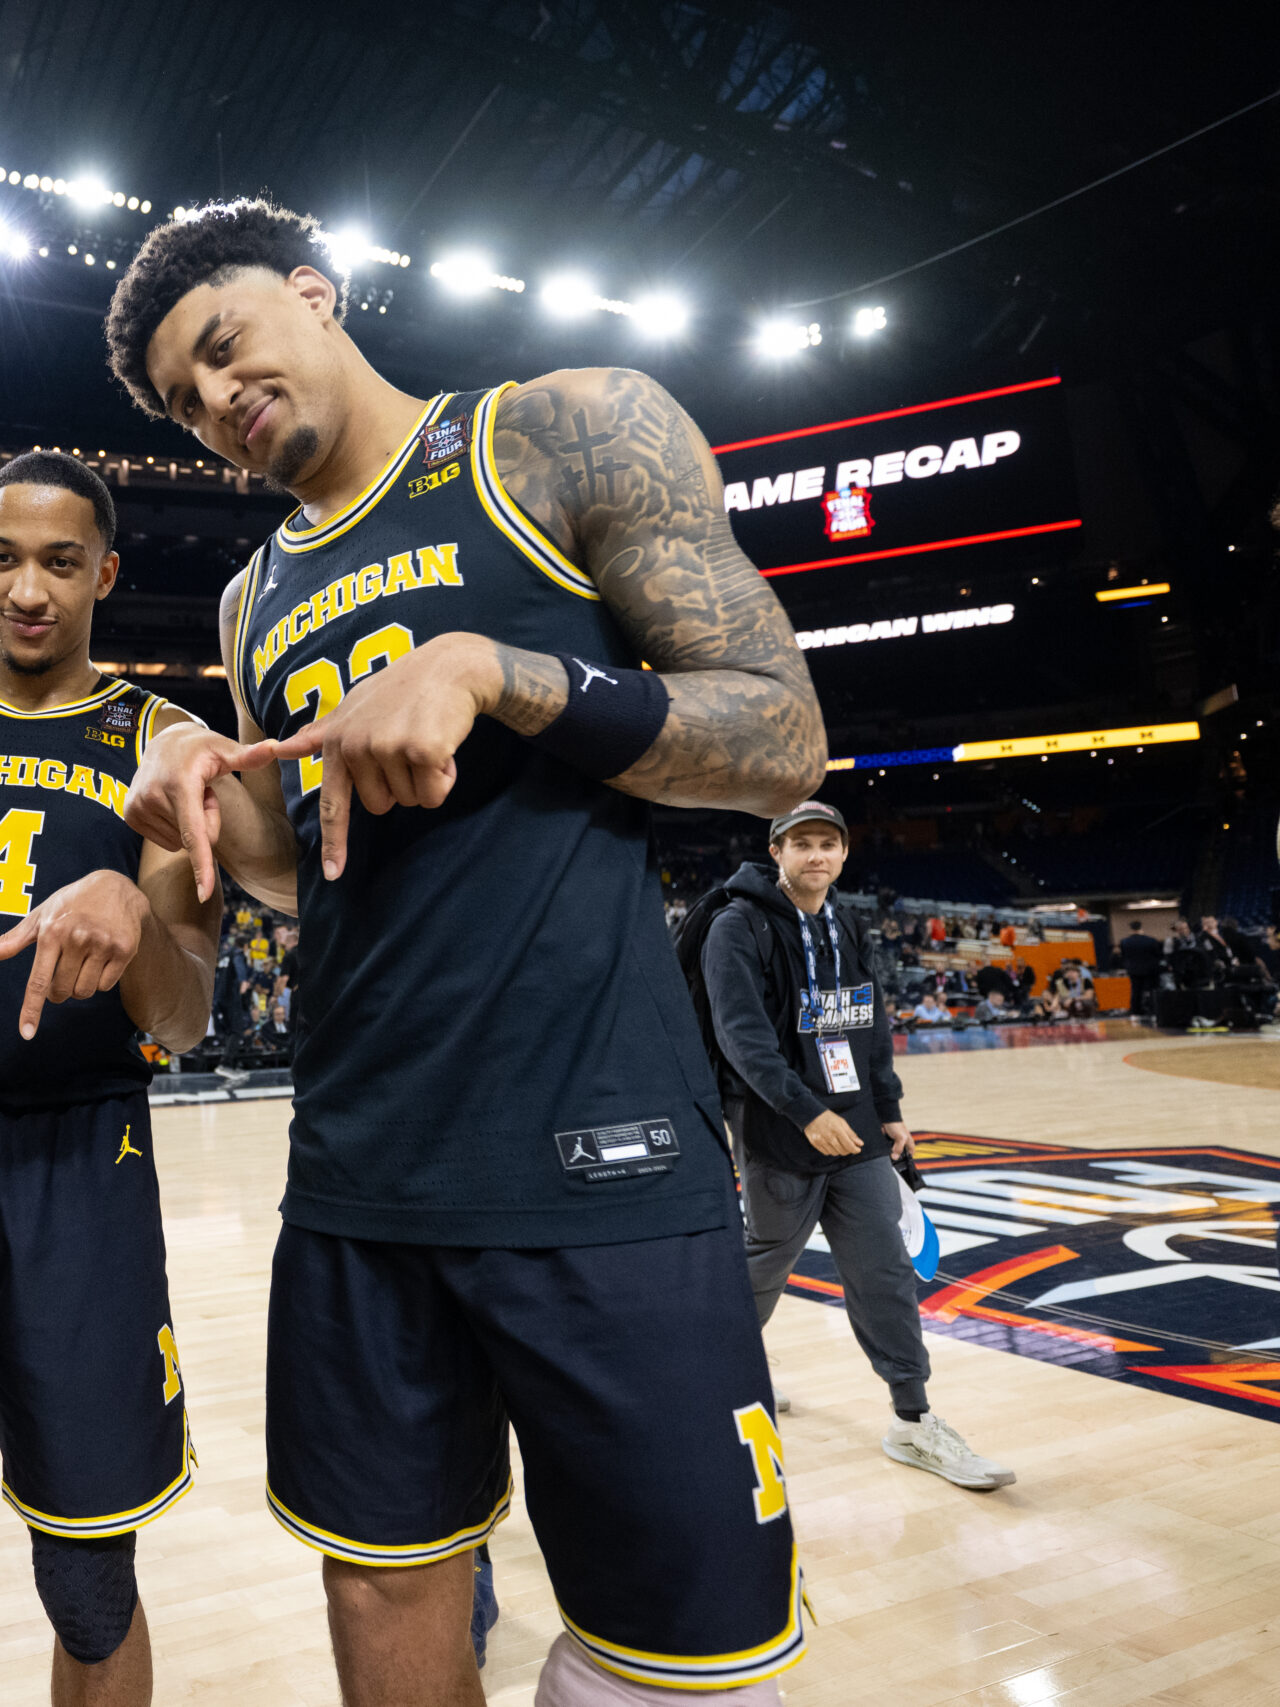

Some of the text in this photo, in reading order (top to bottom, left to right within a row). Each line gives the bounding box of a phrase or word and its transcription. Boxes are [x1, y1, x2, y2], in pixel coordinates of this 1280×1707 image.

[426, 422, 462, 443] FINAL
[429, 439, 463, 461] FOUR
[723, 430, 1021, 513] AME RECAP
[253, 543, 464, 690] MICHIGAN
[795, 603, 1016, 650] CHIGAN WINS
[107, 704, 134, 715] FINAL
[105, 717, 132, 727] FOUR
[649, 1129, 672, 1146] 50
